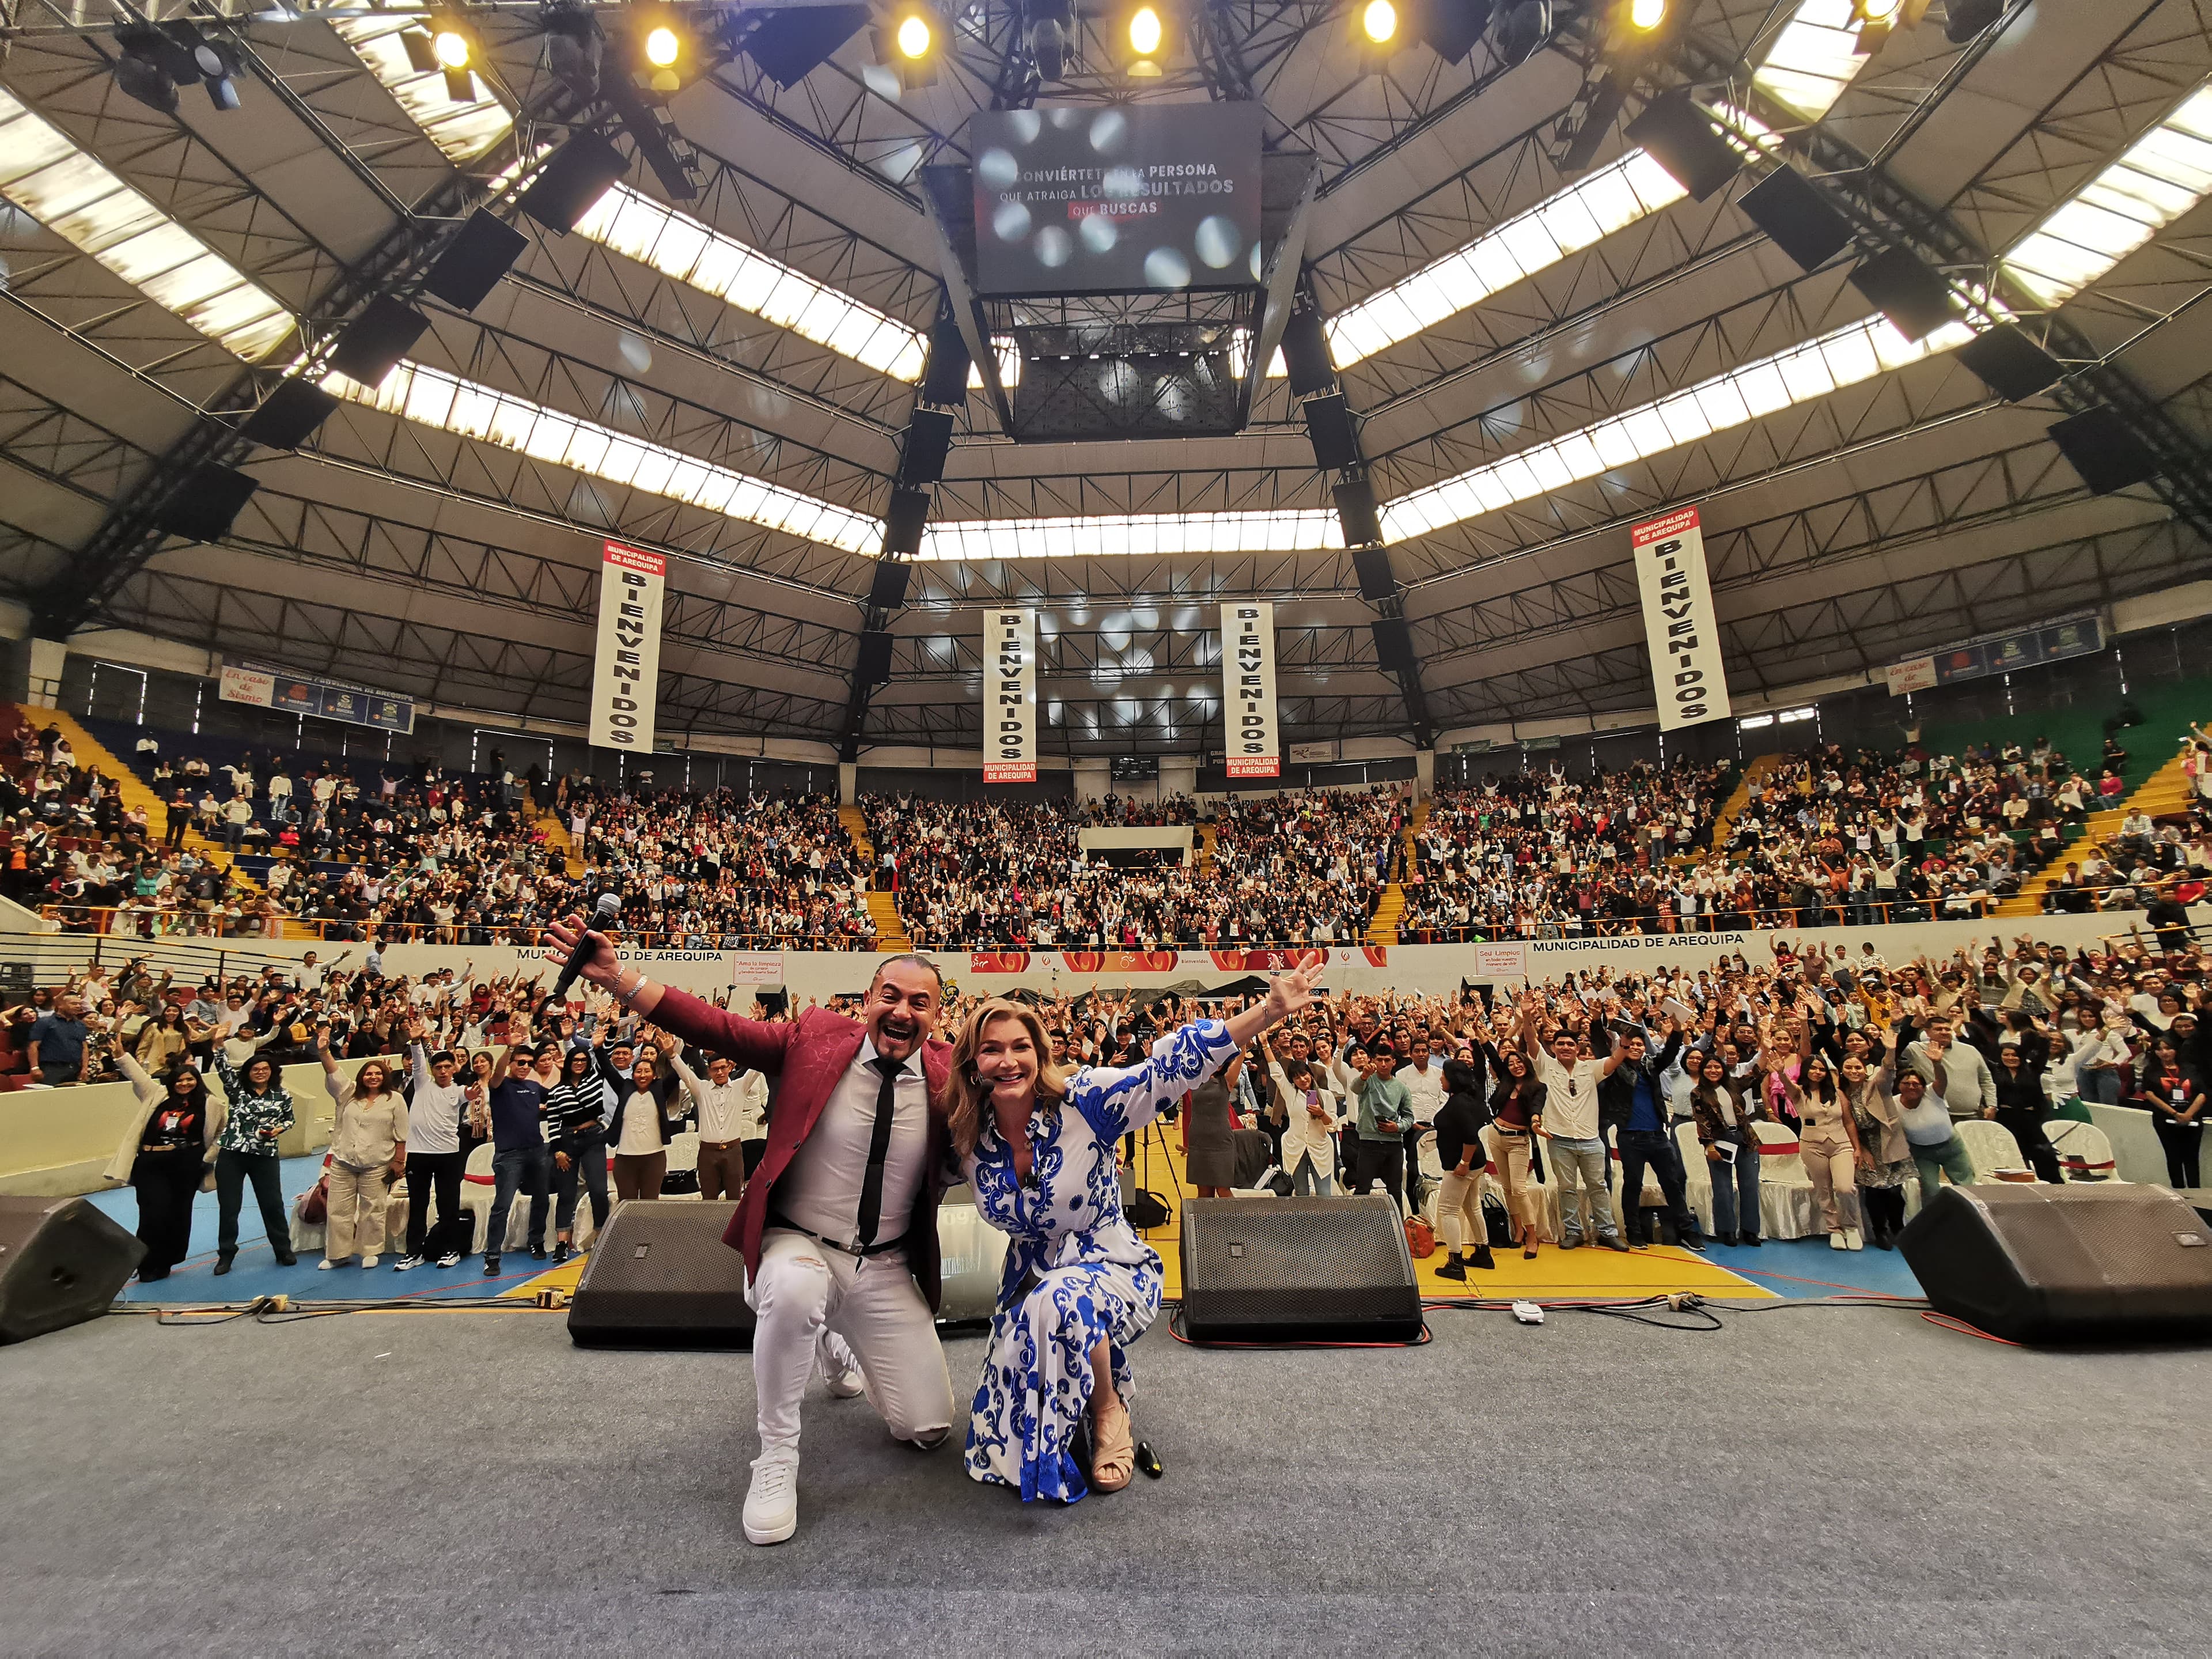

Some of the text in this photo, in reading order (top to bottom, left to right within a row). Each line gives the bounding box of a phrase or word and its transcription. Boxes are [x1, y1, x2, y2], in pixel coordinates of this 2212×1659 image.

[1149, 164, 1217, 177] PERSONA
[1027, 190, 1077, 201] ATRAIGA
[1100, 202, 1157, 216] BUSCAS
[1634, 510, 1694, 536] MUNICIPALIDAD
[1639, 520, 1691, 543] DE AREQUIPA
[607, 545, 663, 565] MUNICIPALIDAD
[611, 554, 658, 572] DE AREQUIPA
[1654, 539, 1707, 719] BIENVENIDOS
[608, 571, 647, 744] BIENVENIDOS
[998, 615, 1023, 759] BIENVENIDOS
[1237, 609, 1266, 754] BIENVENIDOS
[984, 763, 1035, 771] MUNICIPALIDAD
[1226, 757, 1278, 767] MUNICIPALIDAD
[1533, 933, 1744, 952] MUNICIPALIDAD DE AREQUIPA
[634, 951, 653, 961] DE
[656, 951, 723, 961] AREQUIPA
